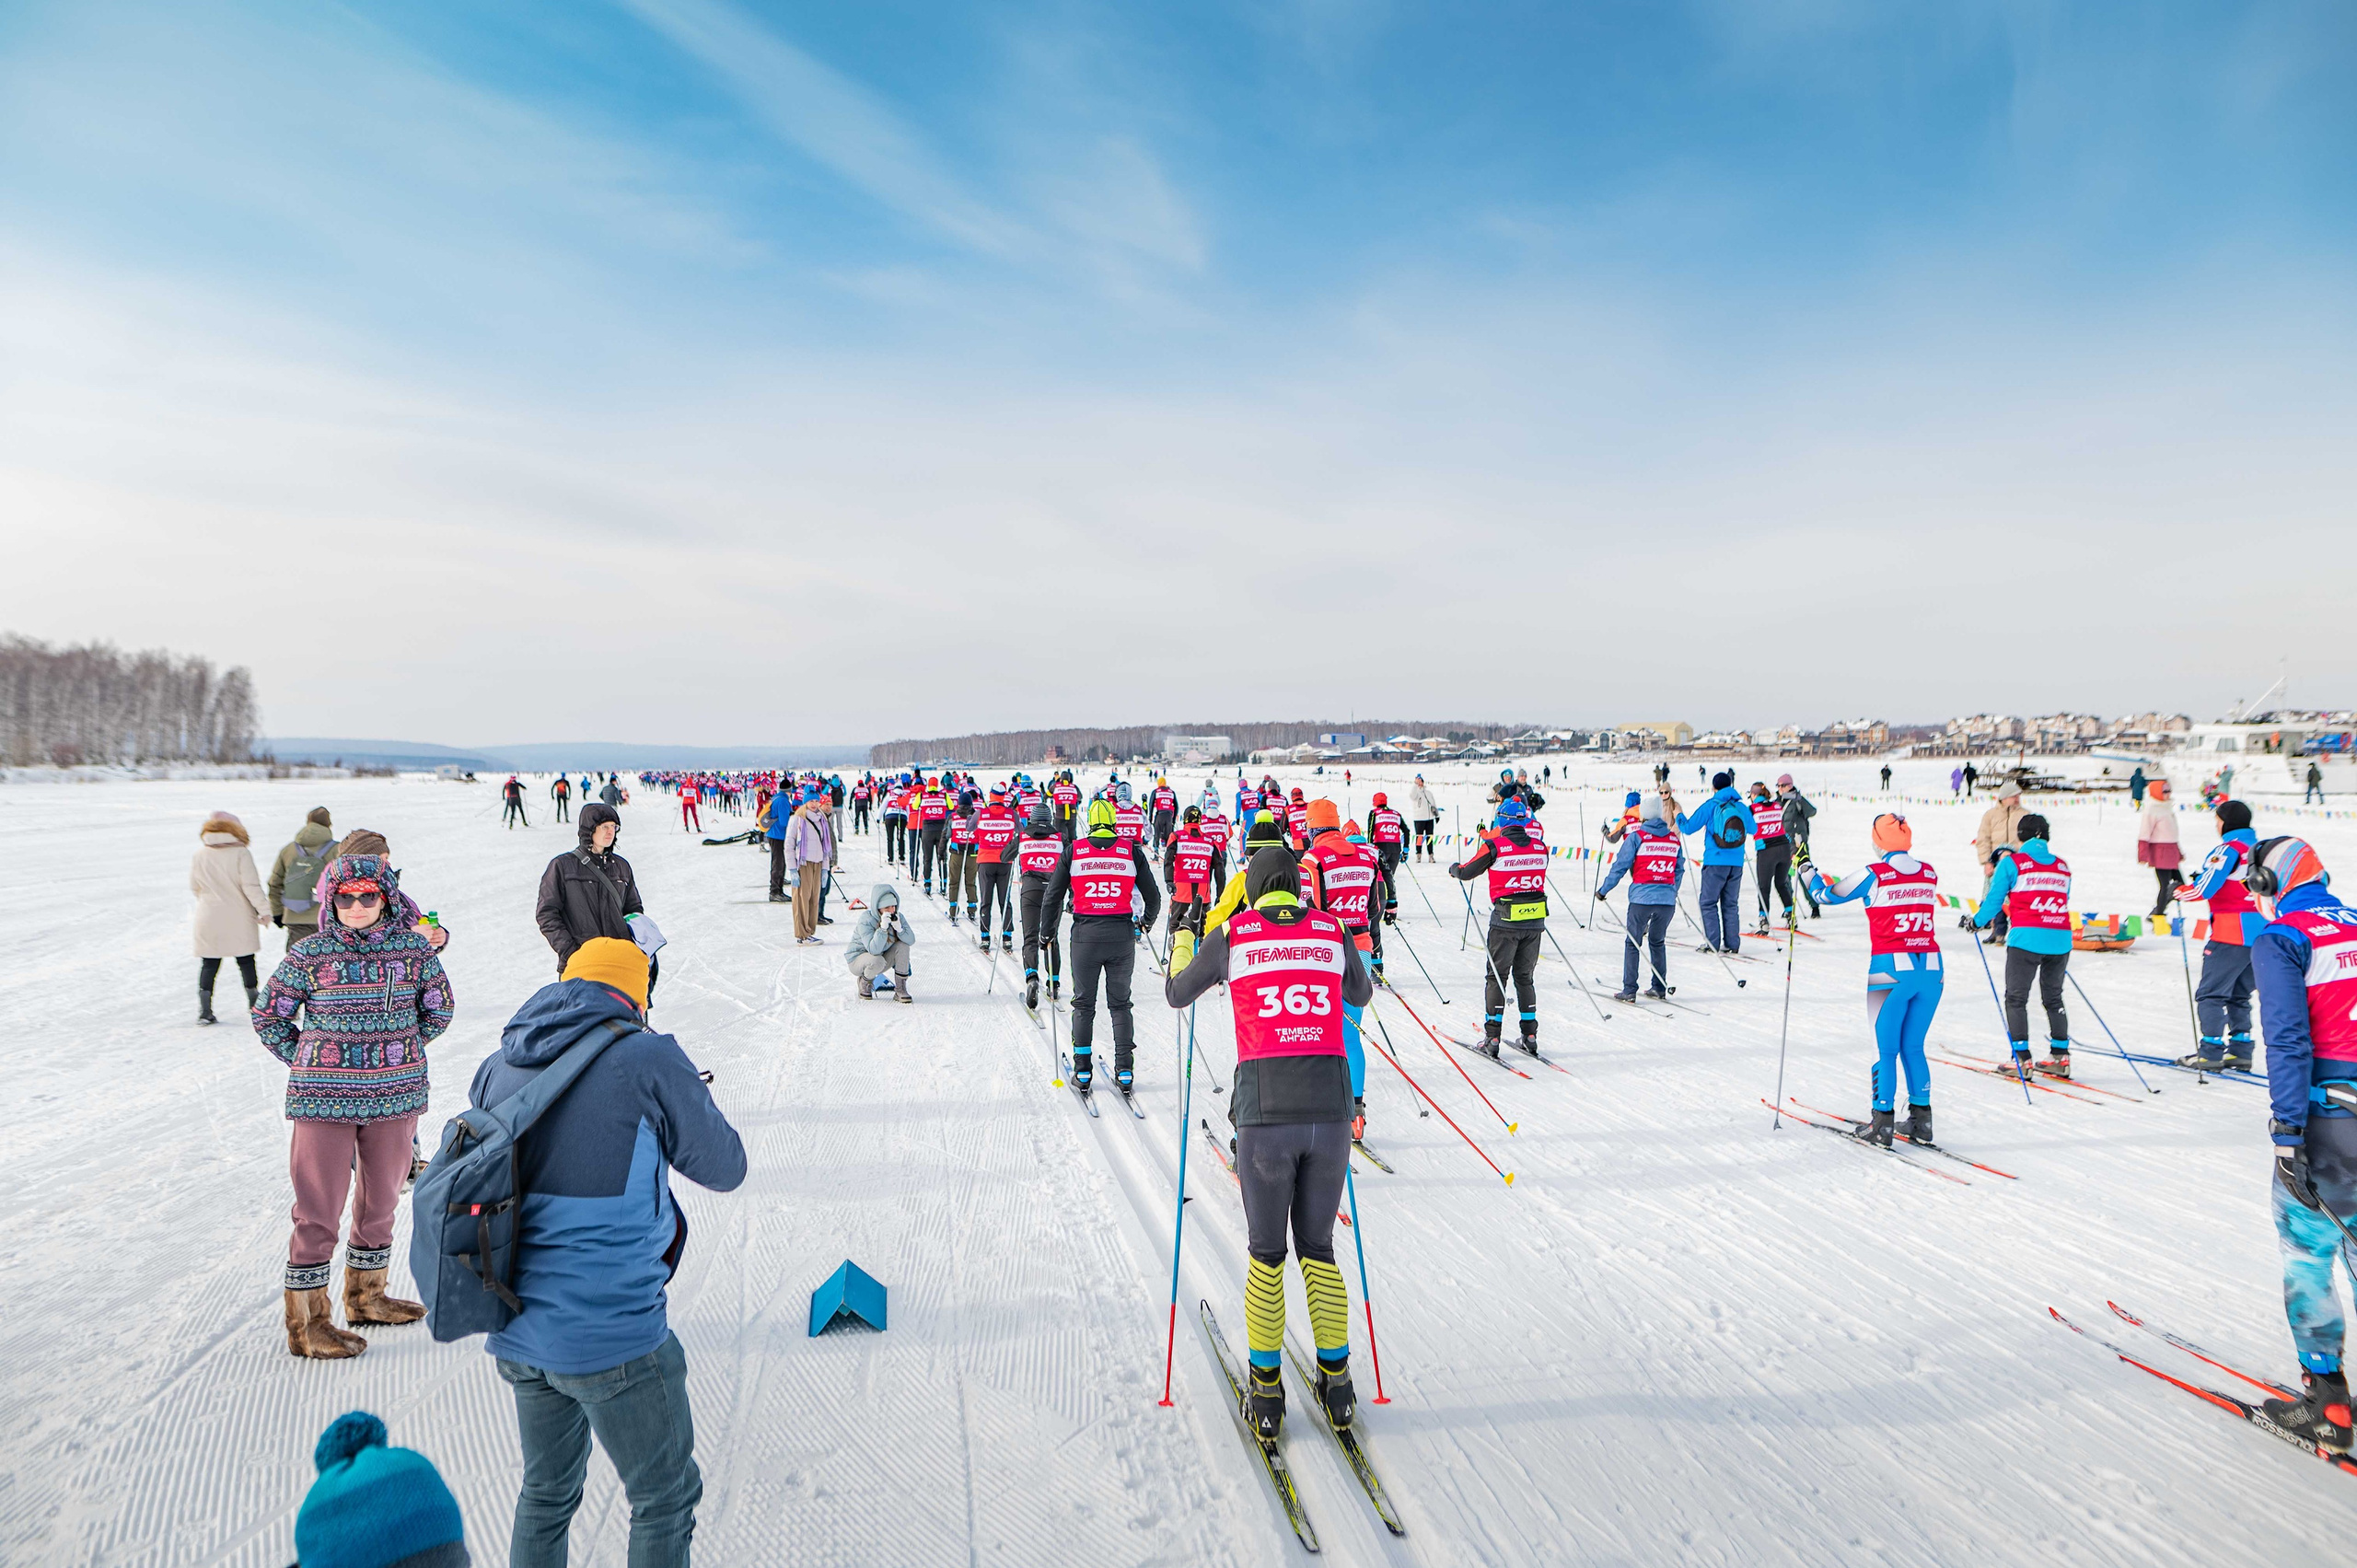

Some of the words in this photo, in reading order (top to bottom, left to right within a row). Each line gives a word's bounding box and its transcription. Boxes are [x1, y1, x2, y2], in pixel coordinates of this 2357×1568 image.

[1116, 827, 1137, 836] 353
[1379, 824, 1399, 833] 460
[984, 833, 1009, 842] 487
[1183, 858, 1207, 870] 278
[1646, 860, 1674, 873] 434
[1504, 876, 1543, 889] 450
[1085, 882, 1121, 898] 255
[1329, 895, 1367, 912] 448
[1894, 912, 1933, 933] 375
[1246, 947, 1333, 966] ТЕМЕРСО
[1256, 984, 1331, 1018] 363
[1274, 1027, 1324, 1035] ТЕМЕРСО
[1279, 1034, 1320, 1042] АНГАРА
